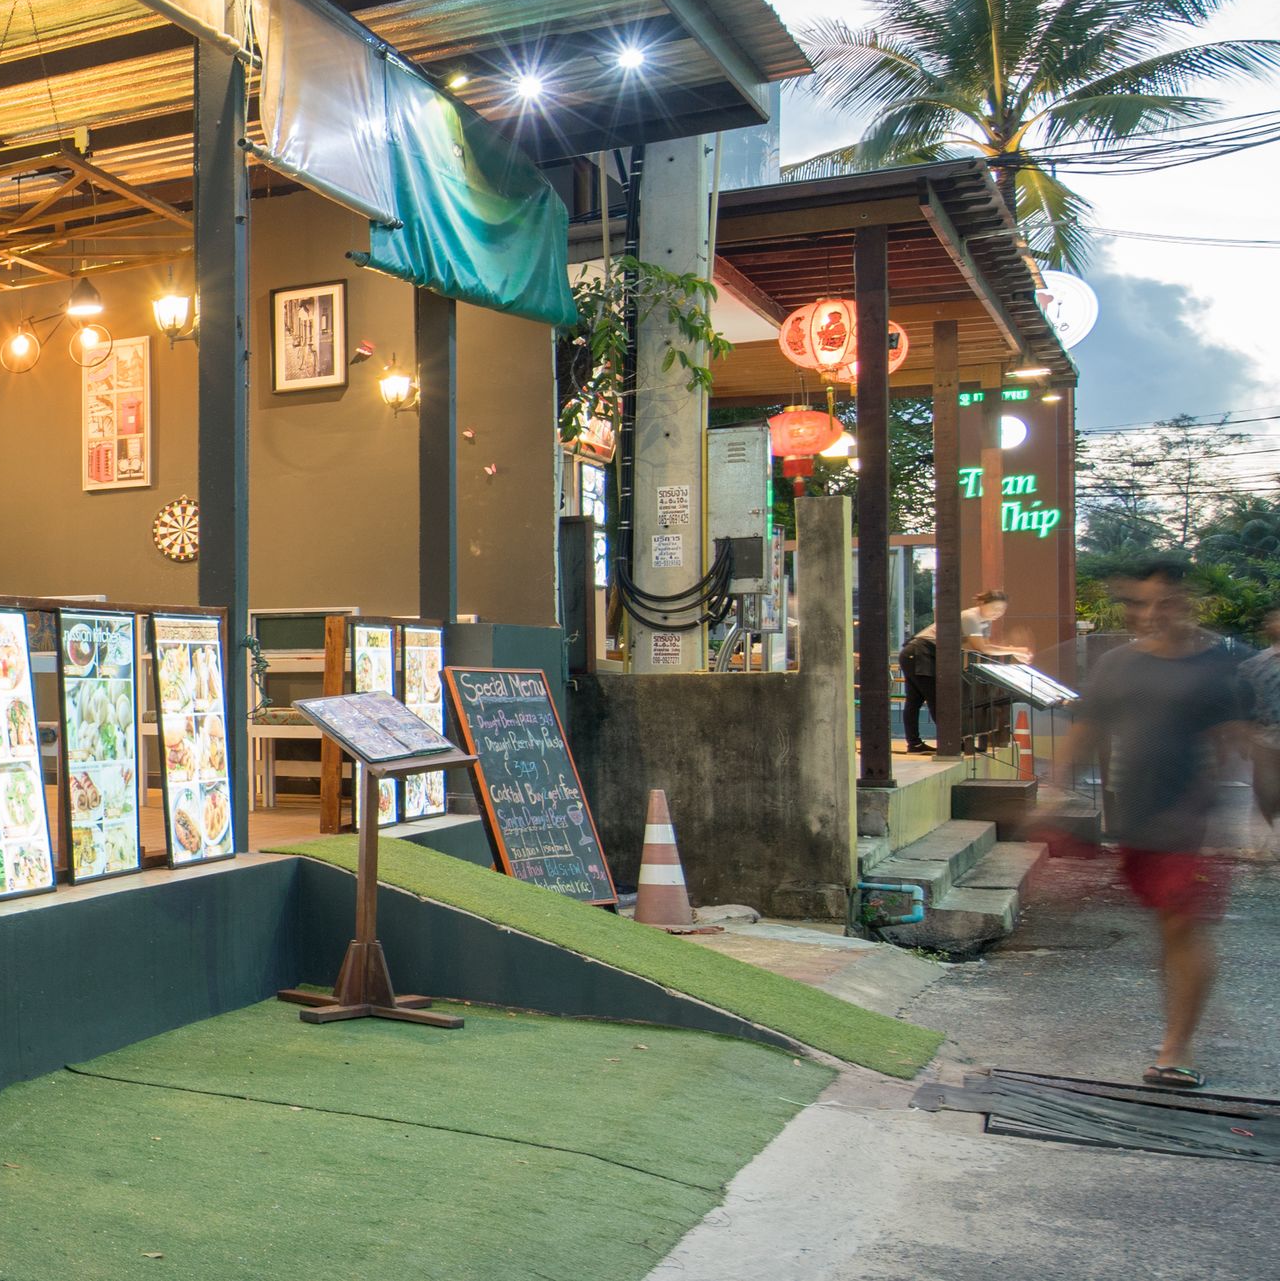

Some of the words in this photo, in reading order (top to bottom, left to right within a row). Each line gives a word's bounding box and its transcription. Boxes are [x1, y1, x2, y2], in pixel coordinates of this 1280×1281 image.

[64, 628, 92, 643] russian
[93, 627, 121, 643] kitchen
[460, 673, 508, 712] Special
[508, 673, 547, 698] Menu
[490, 780, 525, 804] Cocktail
[576, 880, 592, 894] rice
